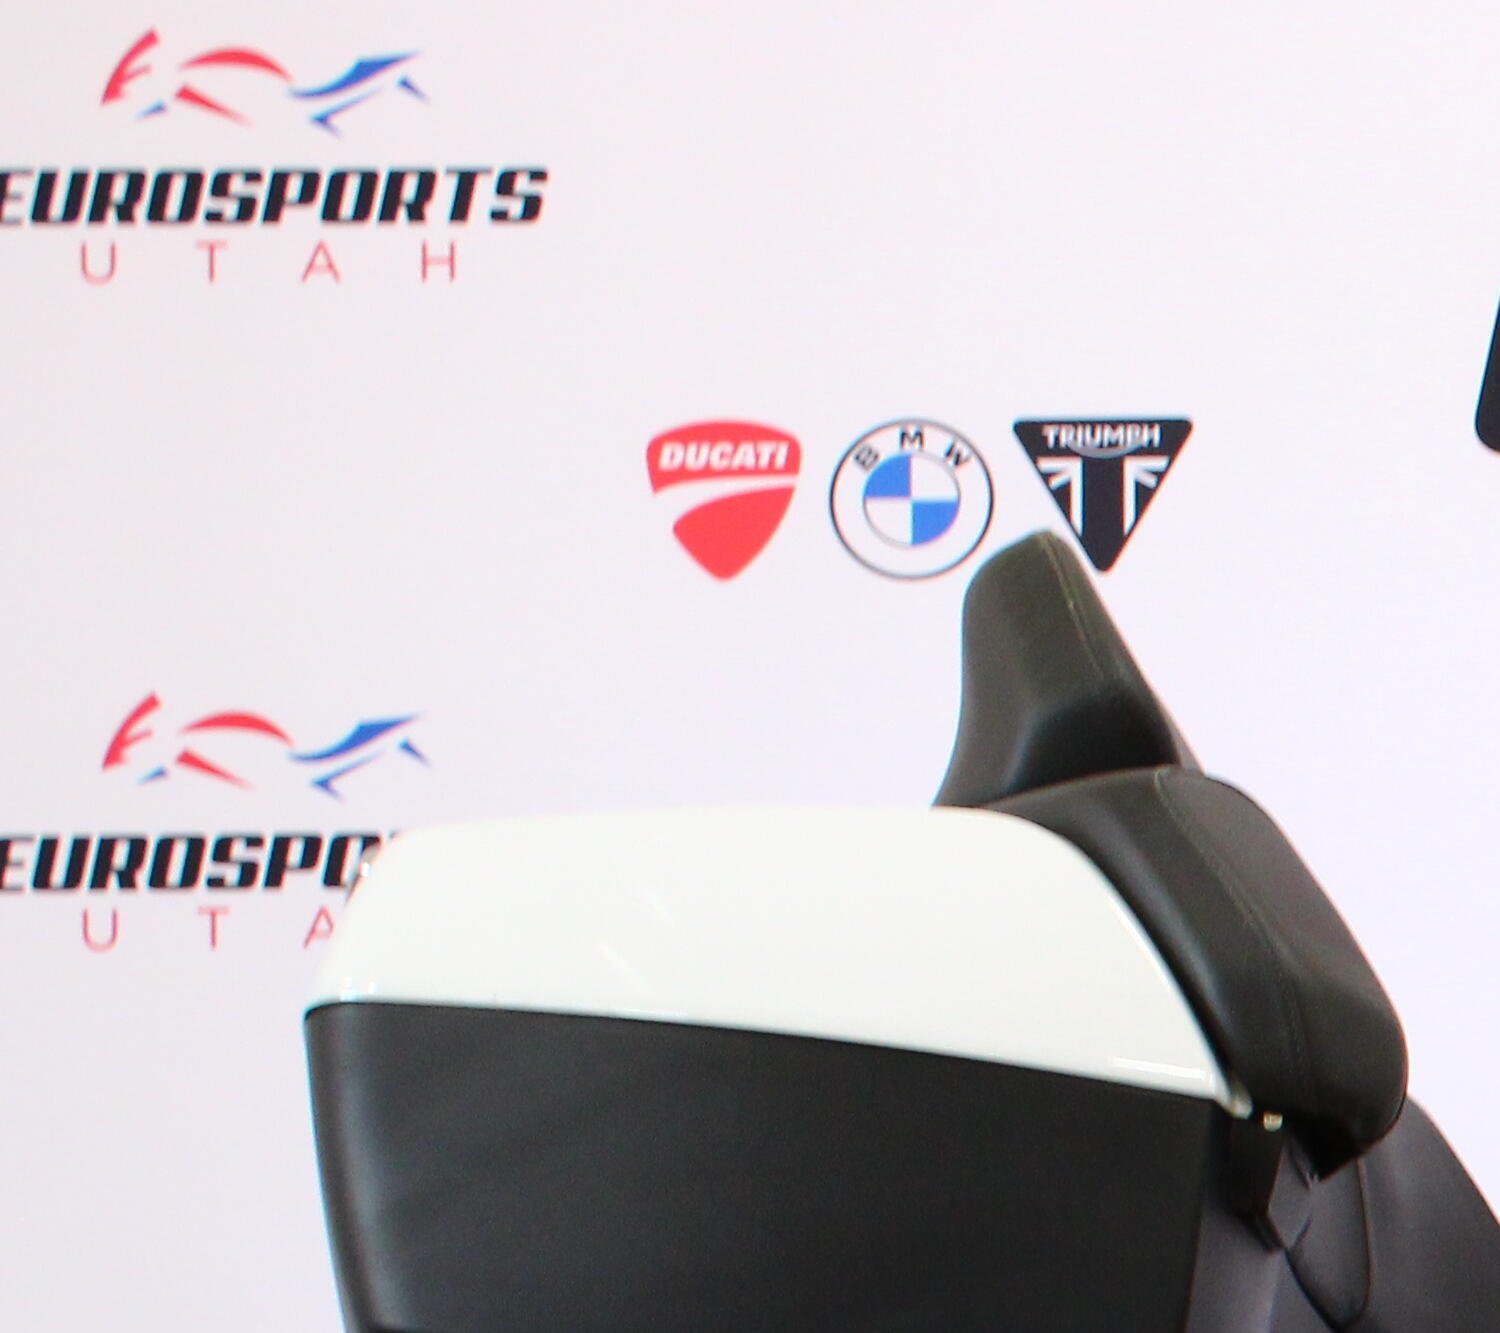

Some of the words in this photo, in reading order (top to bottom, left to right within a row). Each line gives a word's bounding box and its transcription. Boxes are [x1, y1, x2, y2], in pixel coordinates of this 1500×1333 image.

[79, 239, 458, 286] UTAH
[658, 441, 788, 471] DUCATI
[854, 428, 973, 472] BMW
[1042, 424, 1161, 448] TRIUMPH
[0, 831, 399, 894] EUROSPO
[81, 905, 336, 954] UTA
